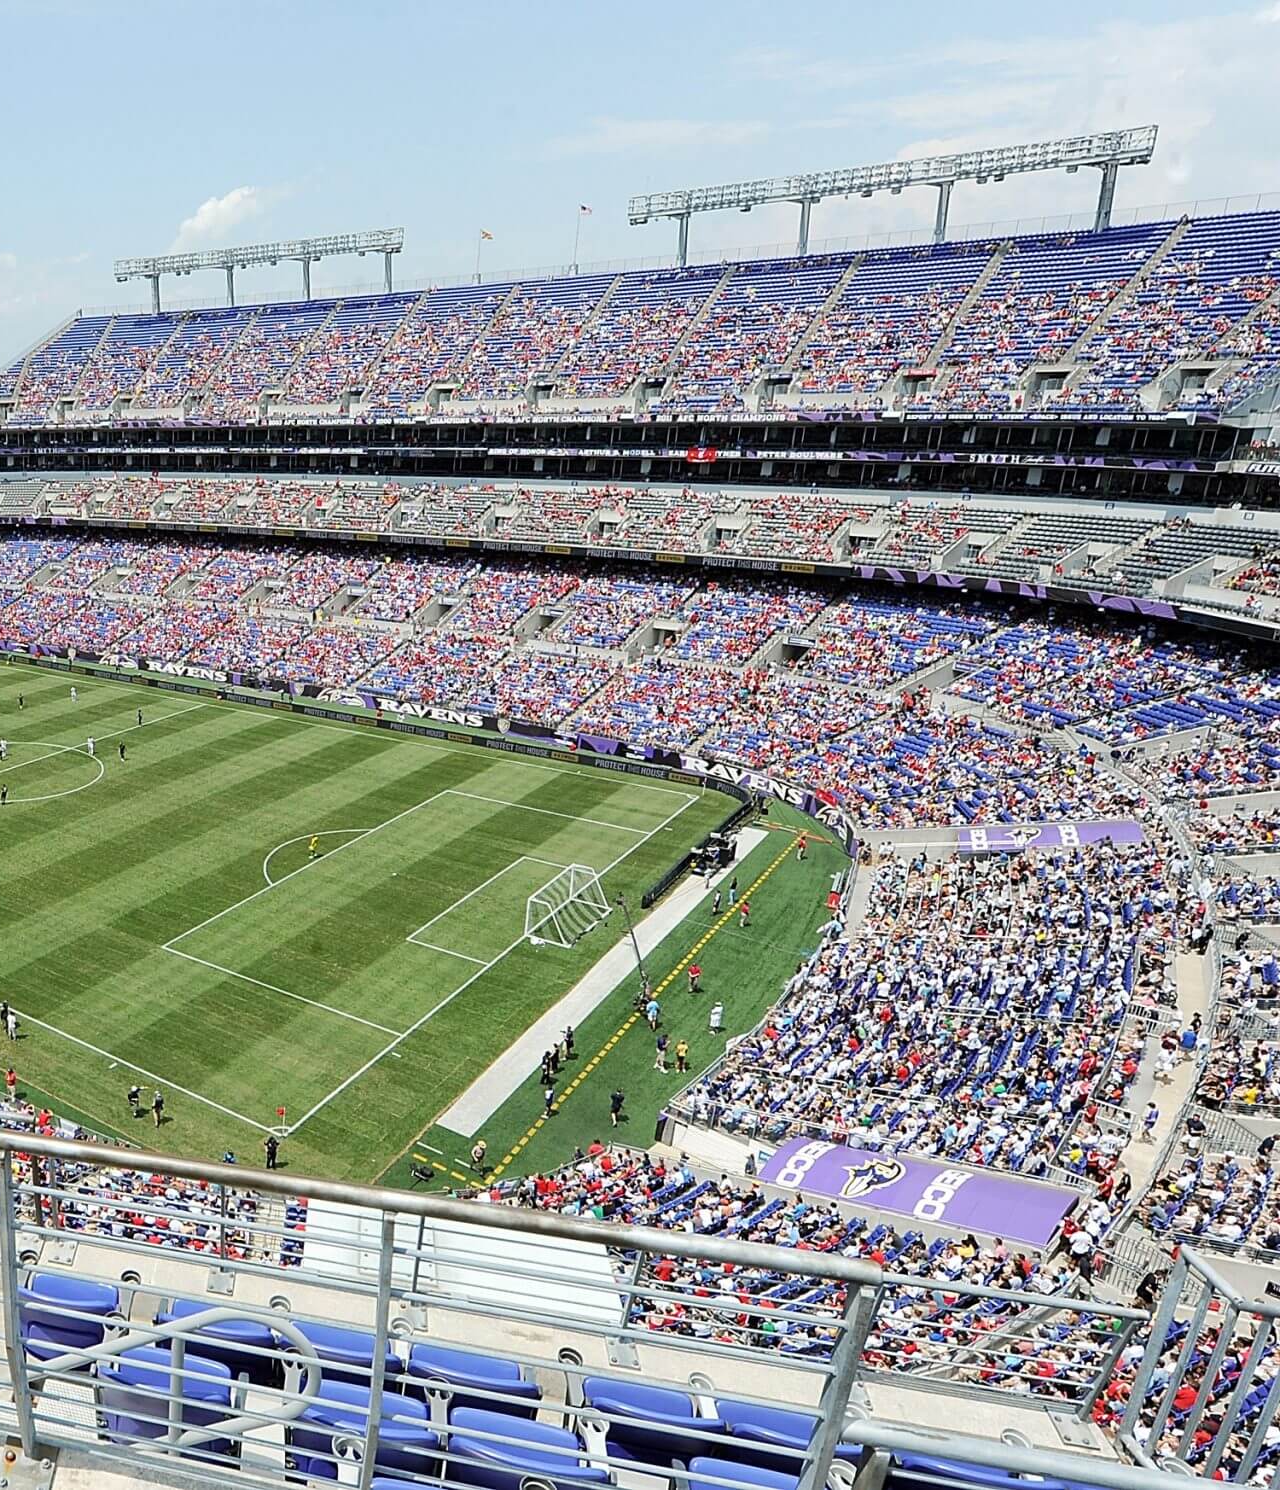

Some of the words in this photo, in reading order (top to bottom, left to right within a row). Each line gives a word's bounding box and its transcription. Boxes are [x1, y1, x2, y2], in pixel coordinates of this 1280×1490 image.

[677, 414, 694, 422] AFC
[696, 414, 728, 422] NORTH
[731, 414, 786, 422] CHAMPIONS
[969, 454, 1021, 464] SMYTH
[587, 549, 617, 559] PROTECT
[702, 557, 735, 568] PROTECT
[146, 660, 228, 682] RAVENS
[376, 697, 484, 728] RAVENS
[486, 740, 514, 752] PROTECT
[595, 759, 626, 771] PROTECT
[685, 755, 805, 805] RAVENS
